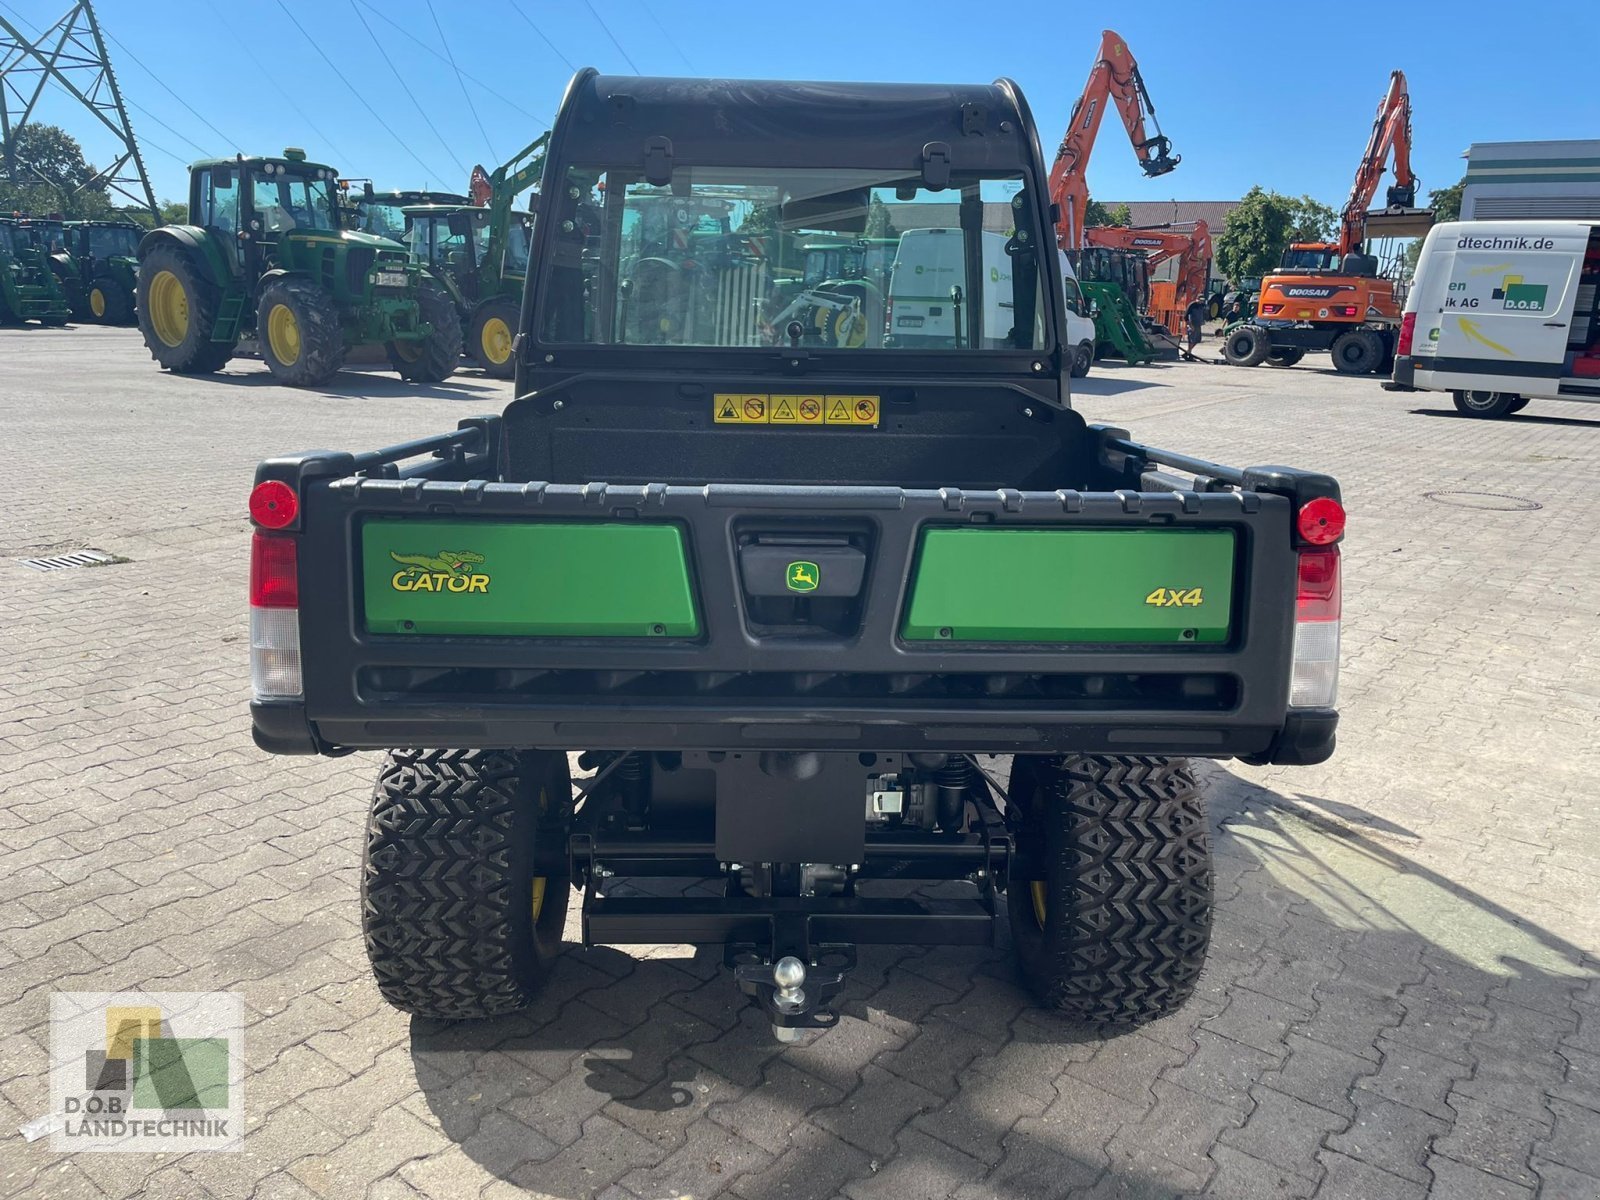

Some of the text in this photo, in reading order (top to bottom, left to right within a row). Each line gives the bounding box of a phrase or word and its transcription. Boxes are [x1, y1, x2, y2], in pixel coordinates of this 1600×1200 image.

[1457, 236, 1554, 250] dtechnik.de
[1448, 281, 1466, 291] en
[1289, 288, 1329, 296] DOOSAN
[1445, 297, 1479, 308] ik AG
[1505, 300, 1543, 310] D.O.B.
[391, 571, 490, 593] GATOR
